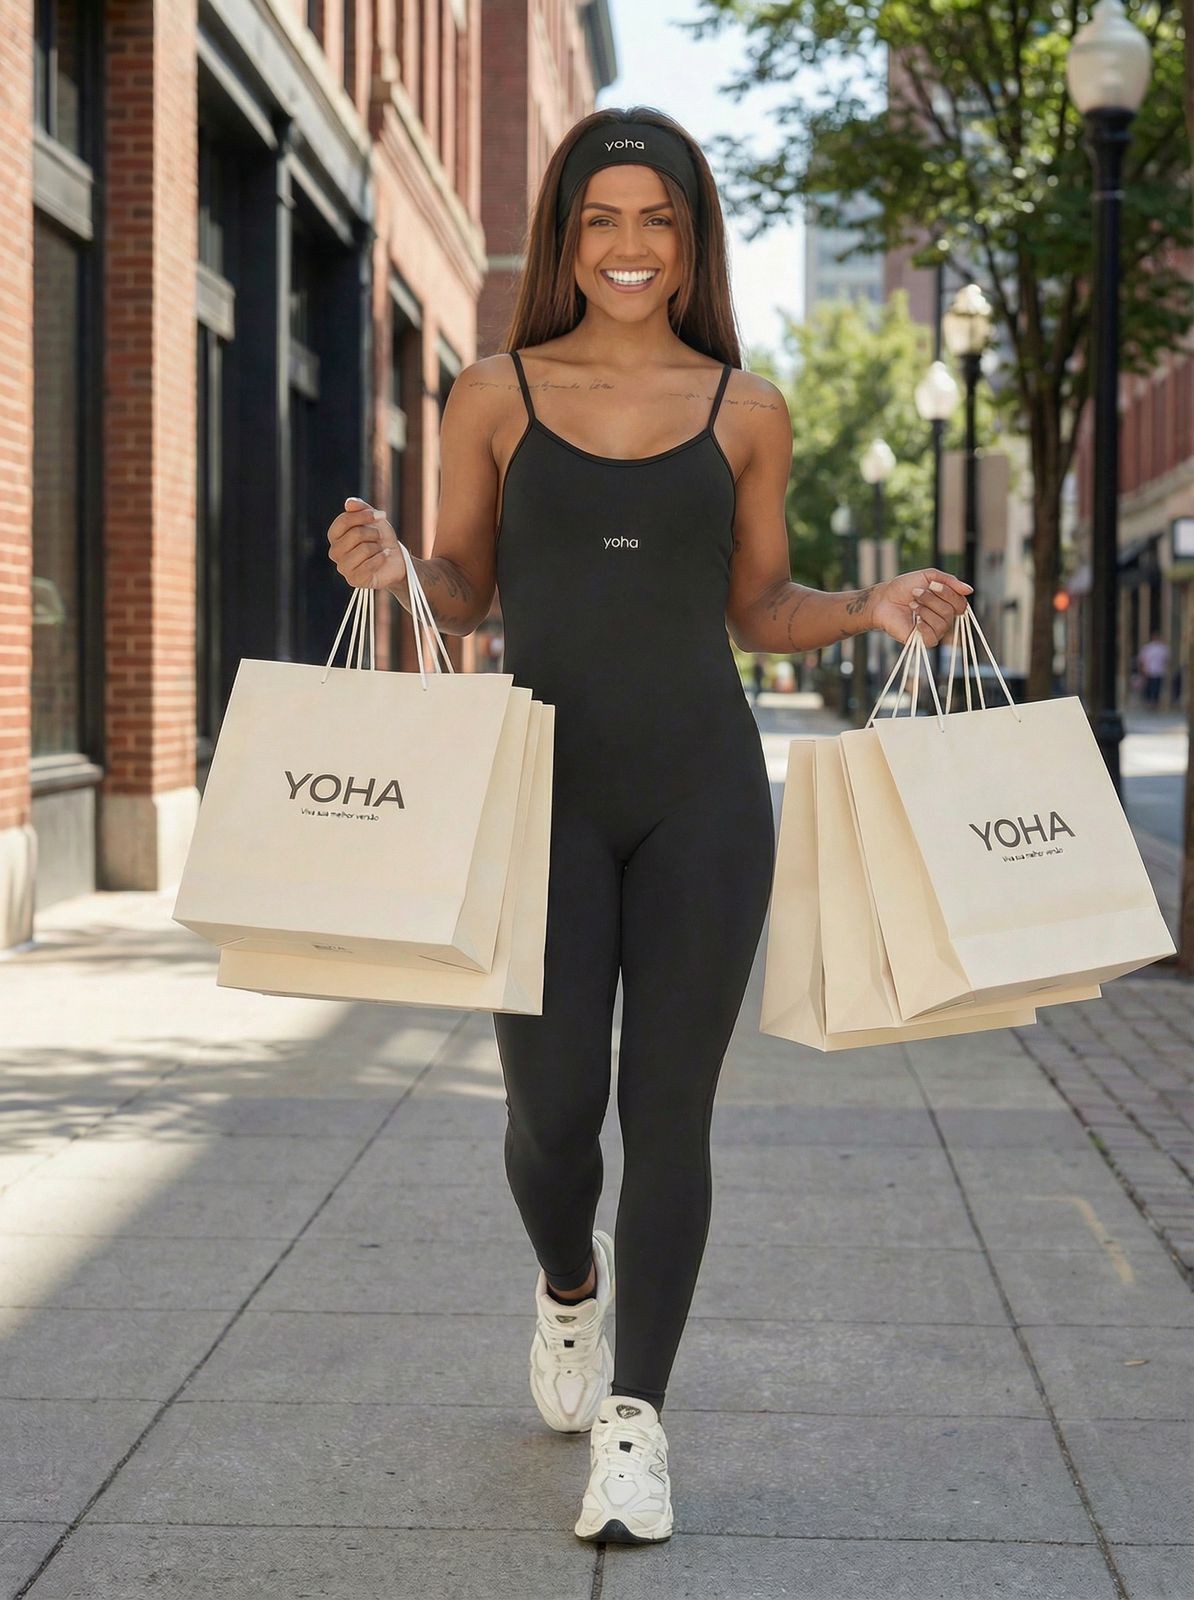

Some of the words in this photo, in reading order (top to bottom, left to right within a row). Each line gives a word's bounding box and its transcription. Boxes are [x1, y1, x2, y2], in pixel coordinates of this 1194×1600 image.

[604, 139, 645, 151] yoha
[603, 535, 639, 549] yoha
[284, 770, 406, 809] YOHA
[968, 811, 1076, 851] YOHA
